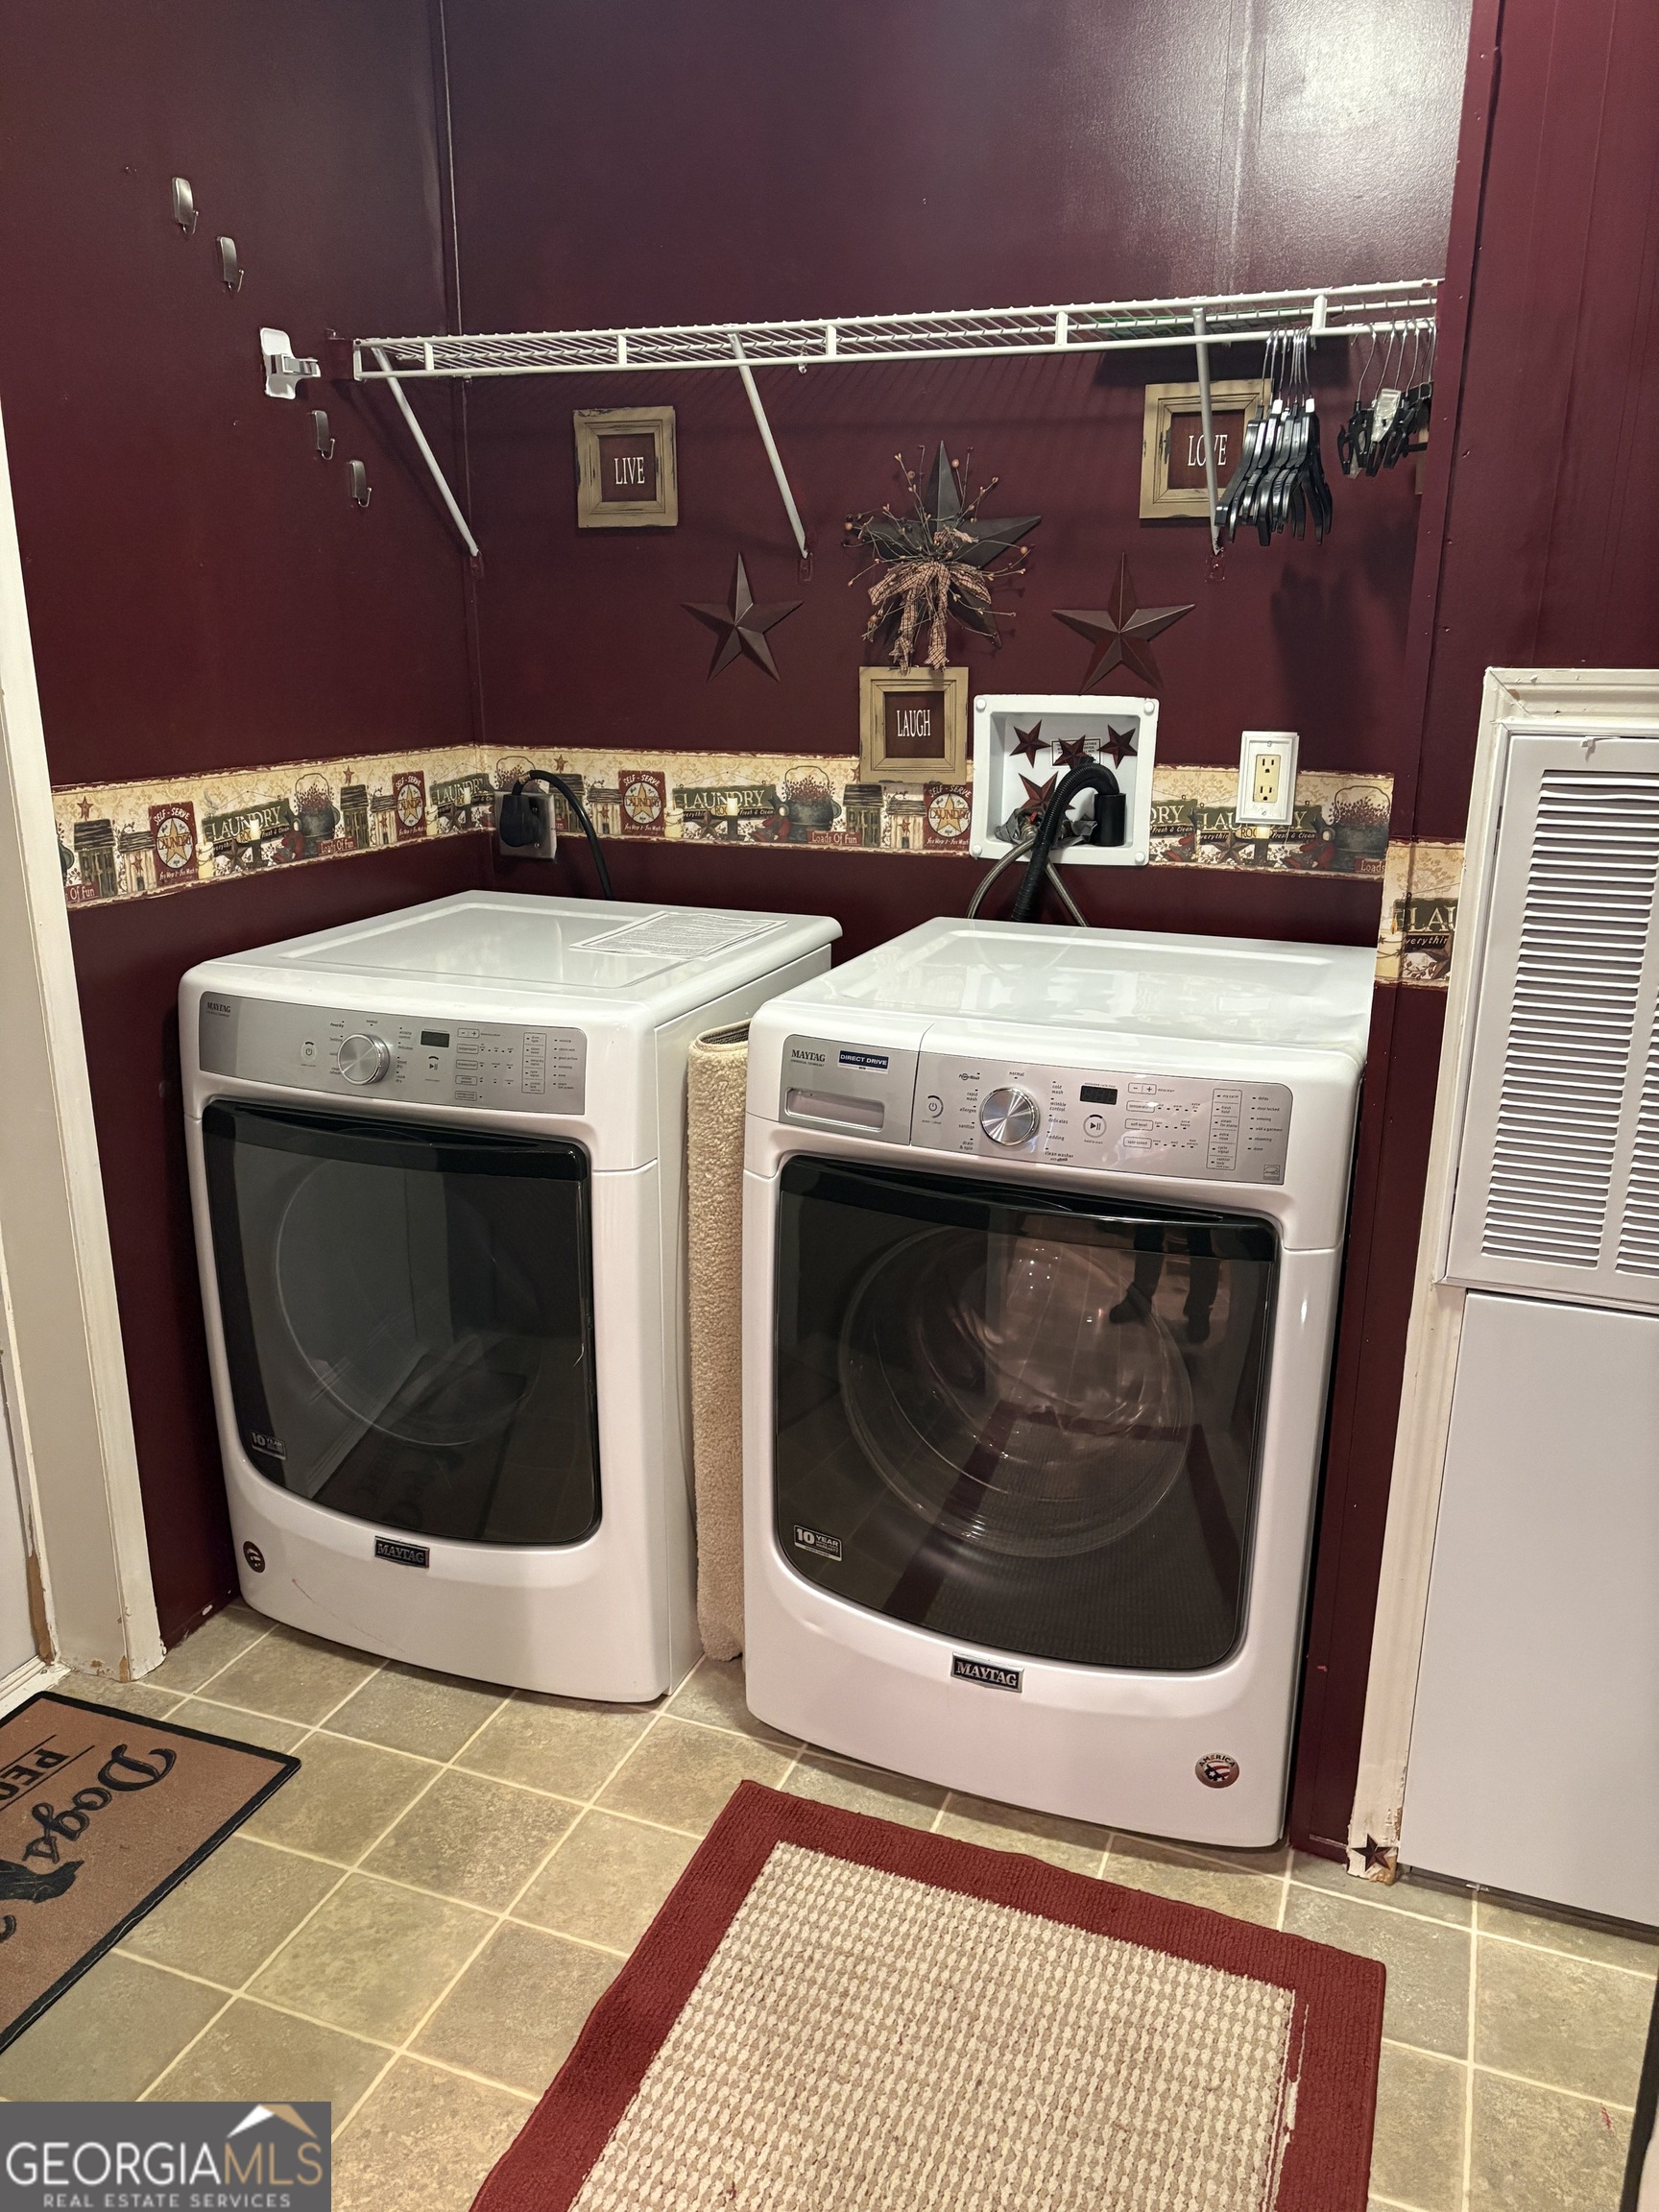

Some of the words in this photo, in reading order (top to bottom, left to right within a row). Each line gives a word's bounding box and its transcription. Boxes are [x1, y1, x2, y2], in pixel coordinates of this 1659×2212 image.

[614, 457, 645, 484] LIVE
[897, 709, 930, 737] LAUGH
[684, 790, 764, 809] LAUNDRY
[212, 806, 281, 841] LAUNDRY
[812, 831, 831, 843] Loads
[833, 832, 843, 846] Of
[845, 834, 856, 844] Fun
[70, 886, 80, 902] Of
[82, 885, 94, 899] Fun
[206, 1002, 230, 1013] MAYTAG
[791, 1049, 826, 1063] MAYTAG
[840, 1054, 865, 1063] DIRECT
[252, 1431, 266, 1446] 10
[796, 1528, 815, 1545] 10
[816, 1534, 839, 1547] YEAR
[377, 1544, 424, 1563] MAYTAG
[957, 1662, 1017, 1686] MAYTAG
[1199, 1754, 1236, 1767] AMERICA
[23, 1743, 178, 1863] Dogs
